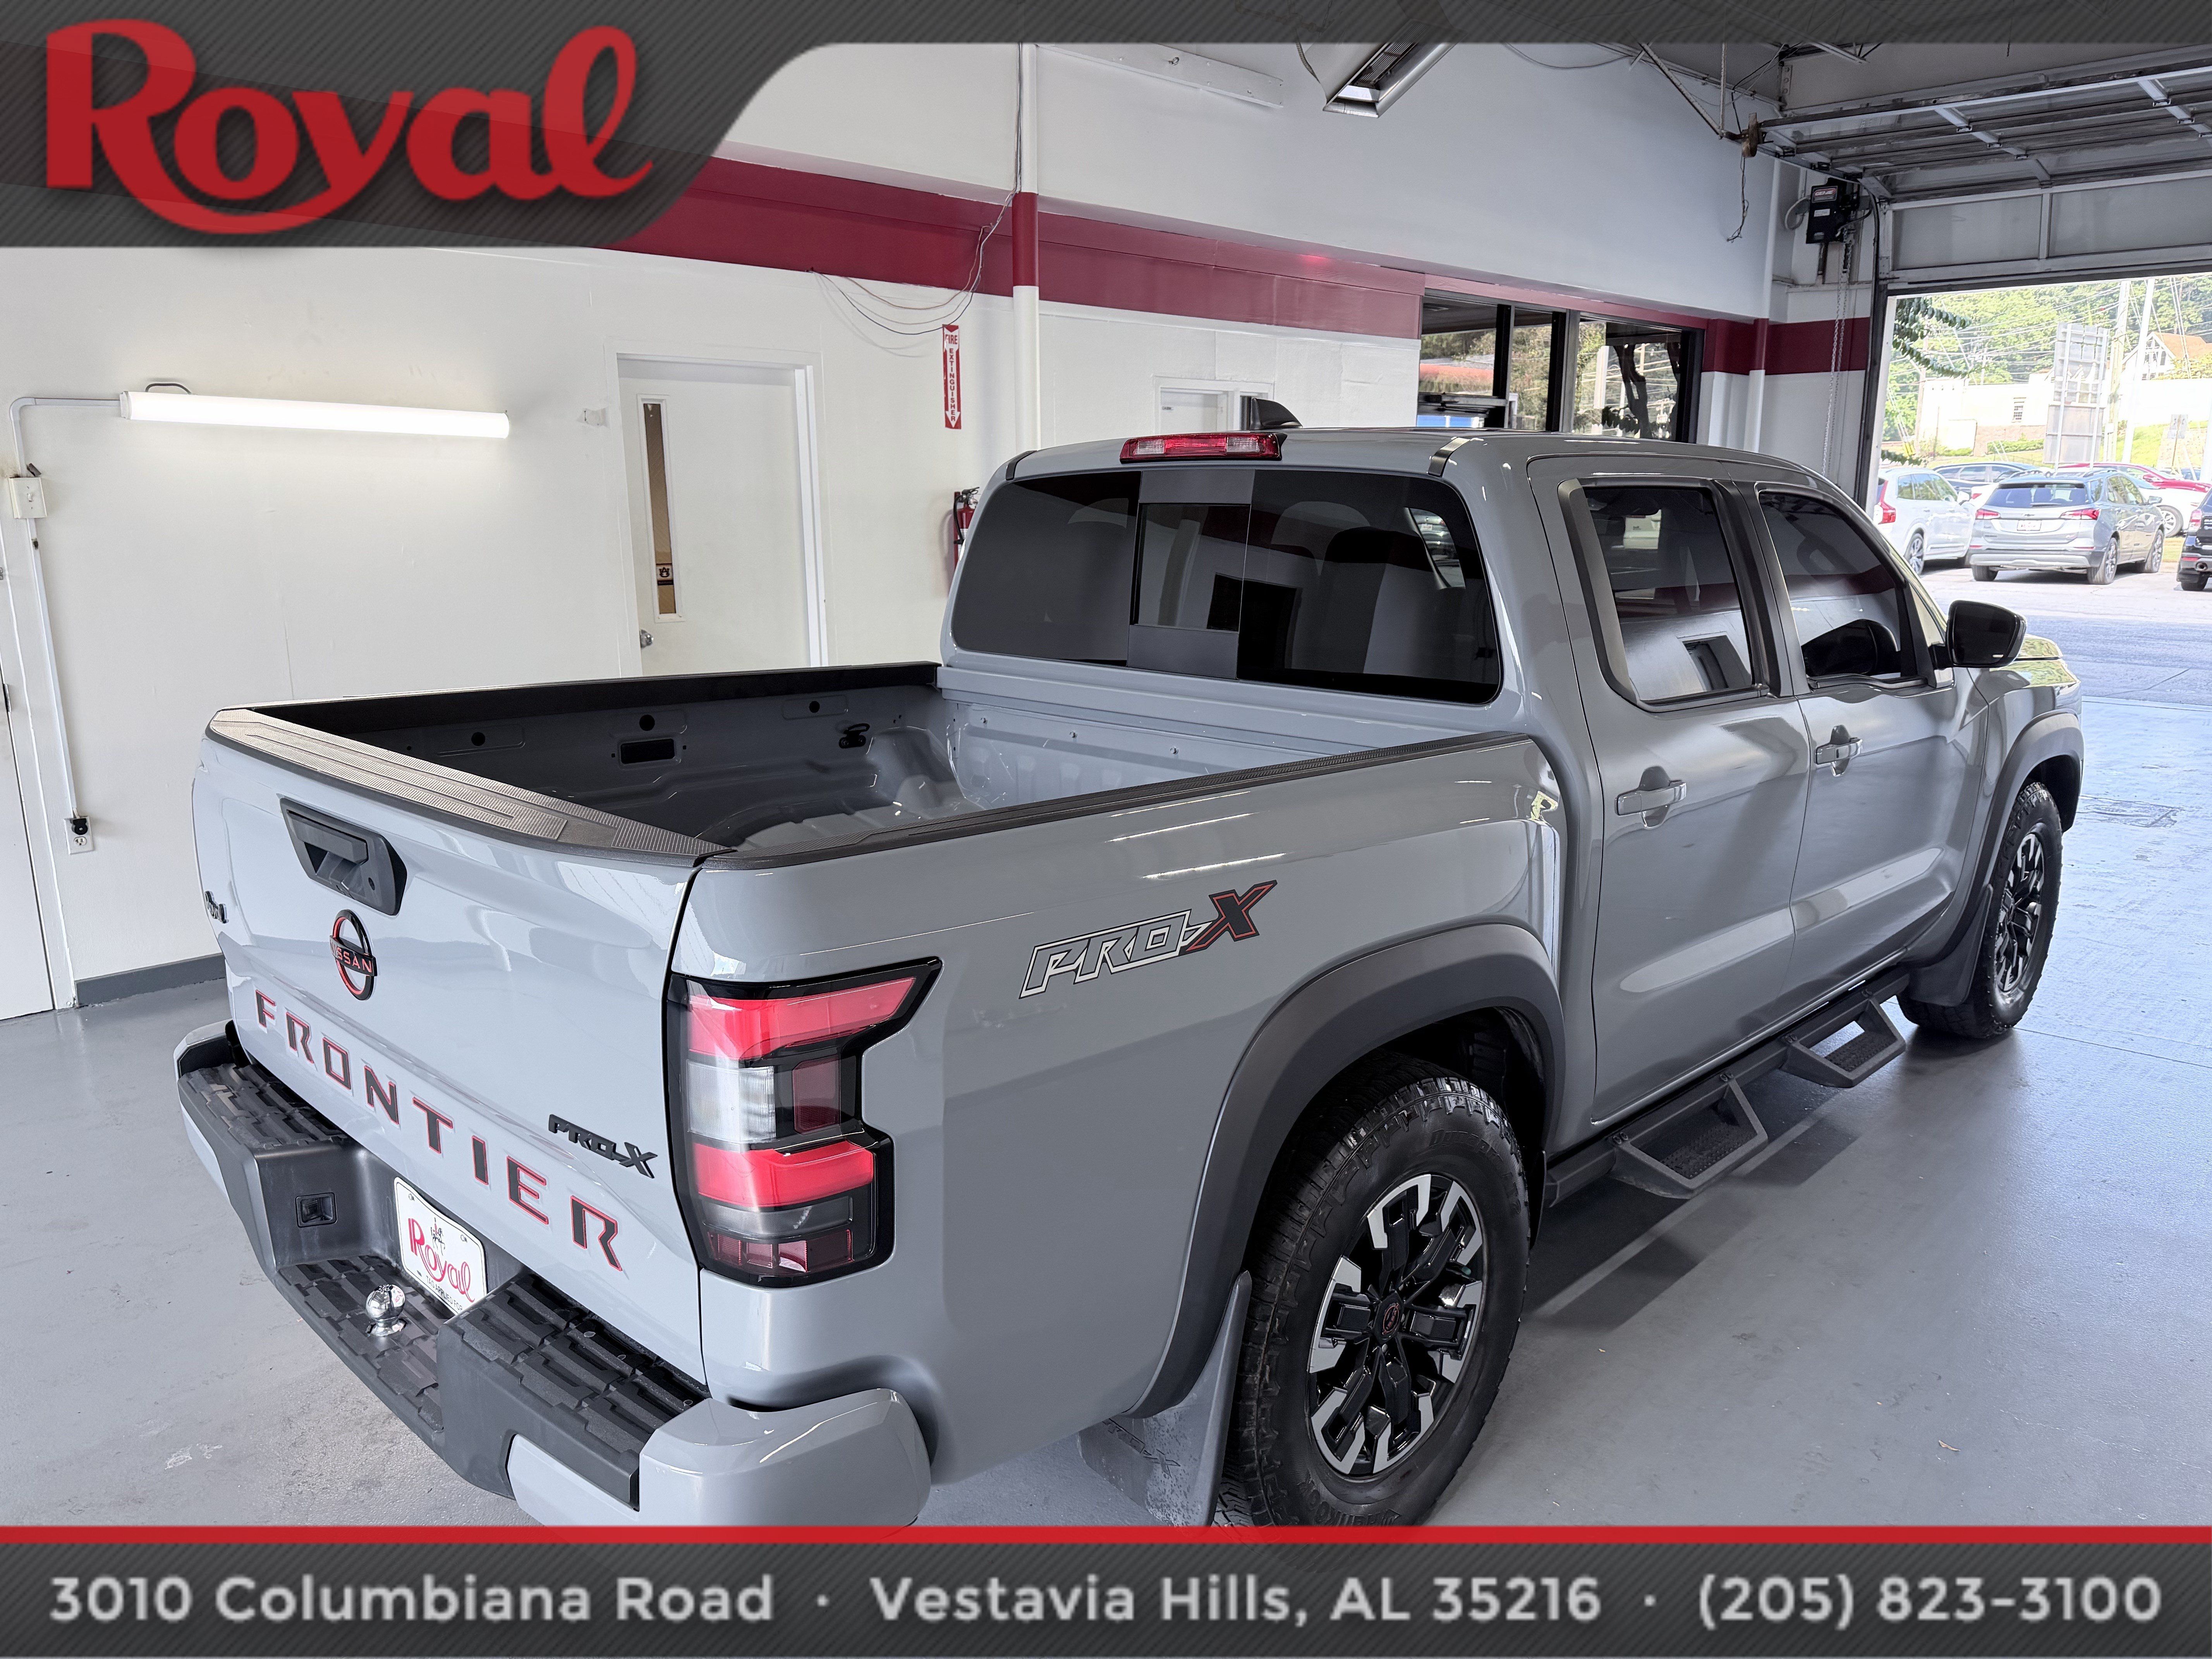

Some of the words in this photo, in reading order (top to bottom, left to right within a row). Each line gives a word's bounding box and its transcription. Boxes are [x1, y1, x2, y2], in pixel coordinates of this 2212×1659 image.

[945, 334, 958, 345] FIRE
[330, 939, 373, 973] NISSAN
[1018, 880, 1278, 999] PRO-X
[255, 989, 623, 1271] FRONTIER
[548, 1114, 658, 1178] PRO-X
[408, 1218, 475, 1303] Royal
[426, 1275, 434, 1288] TAG
[435, 1284, 453, 1304] APPLIED
